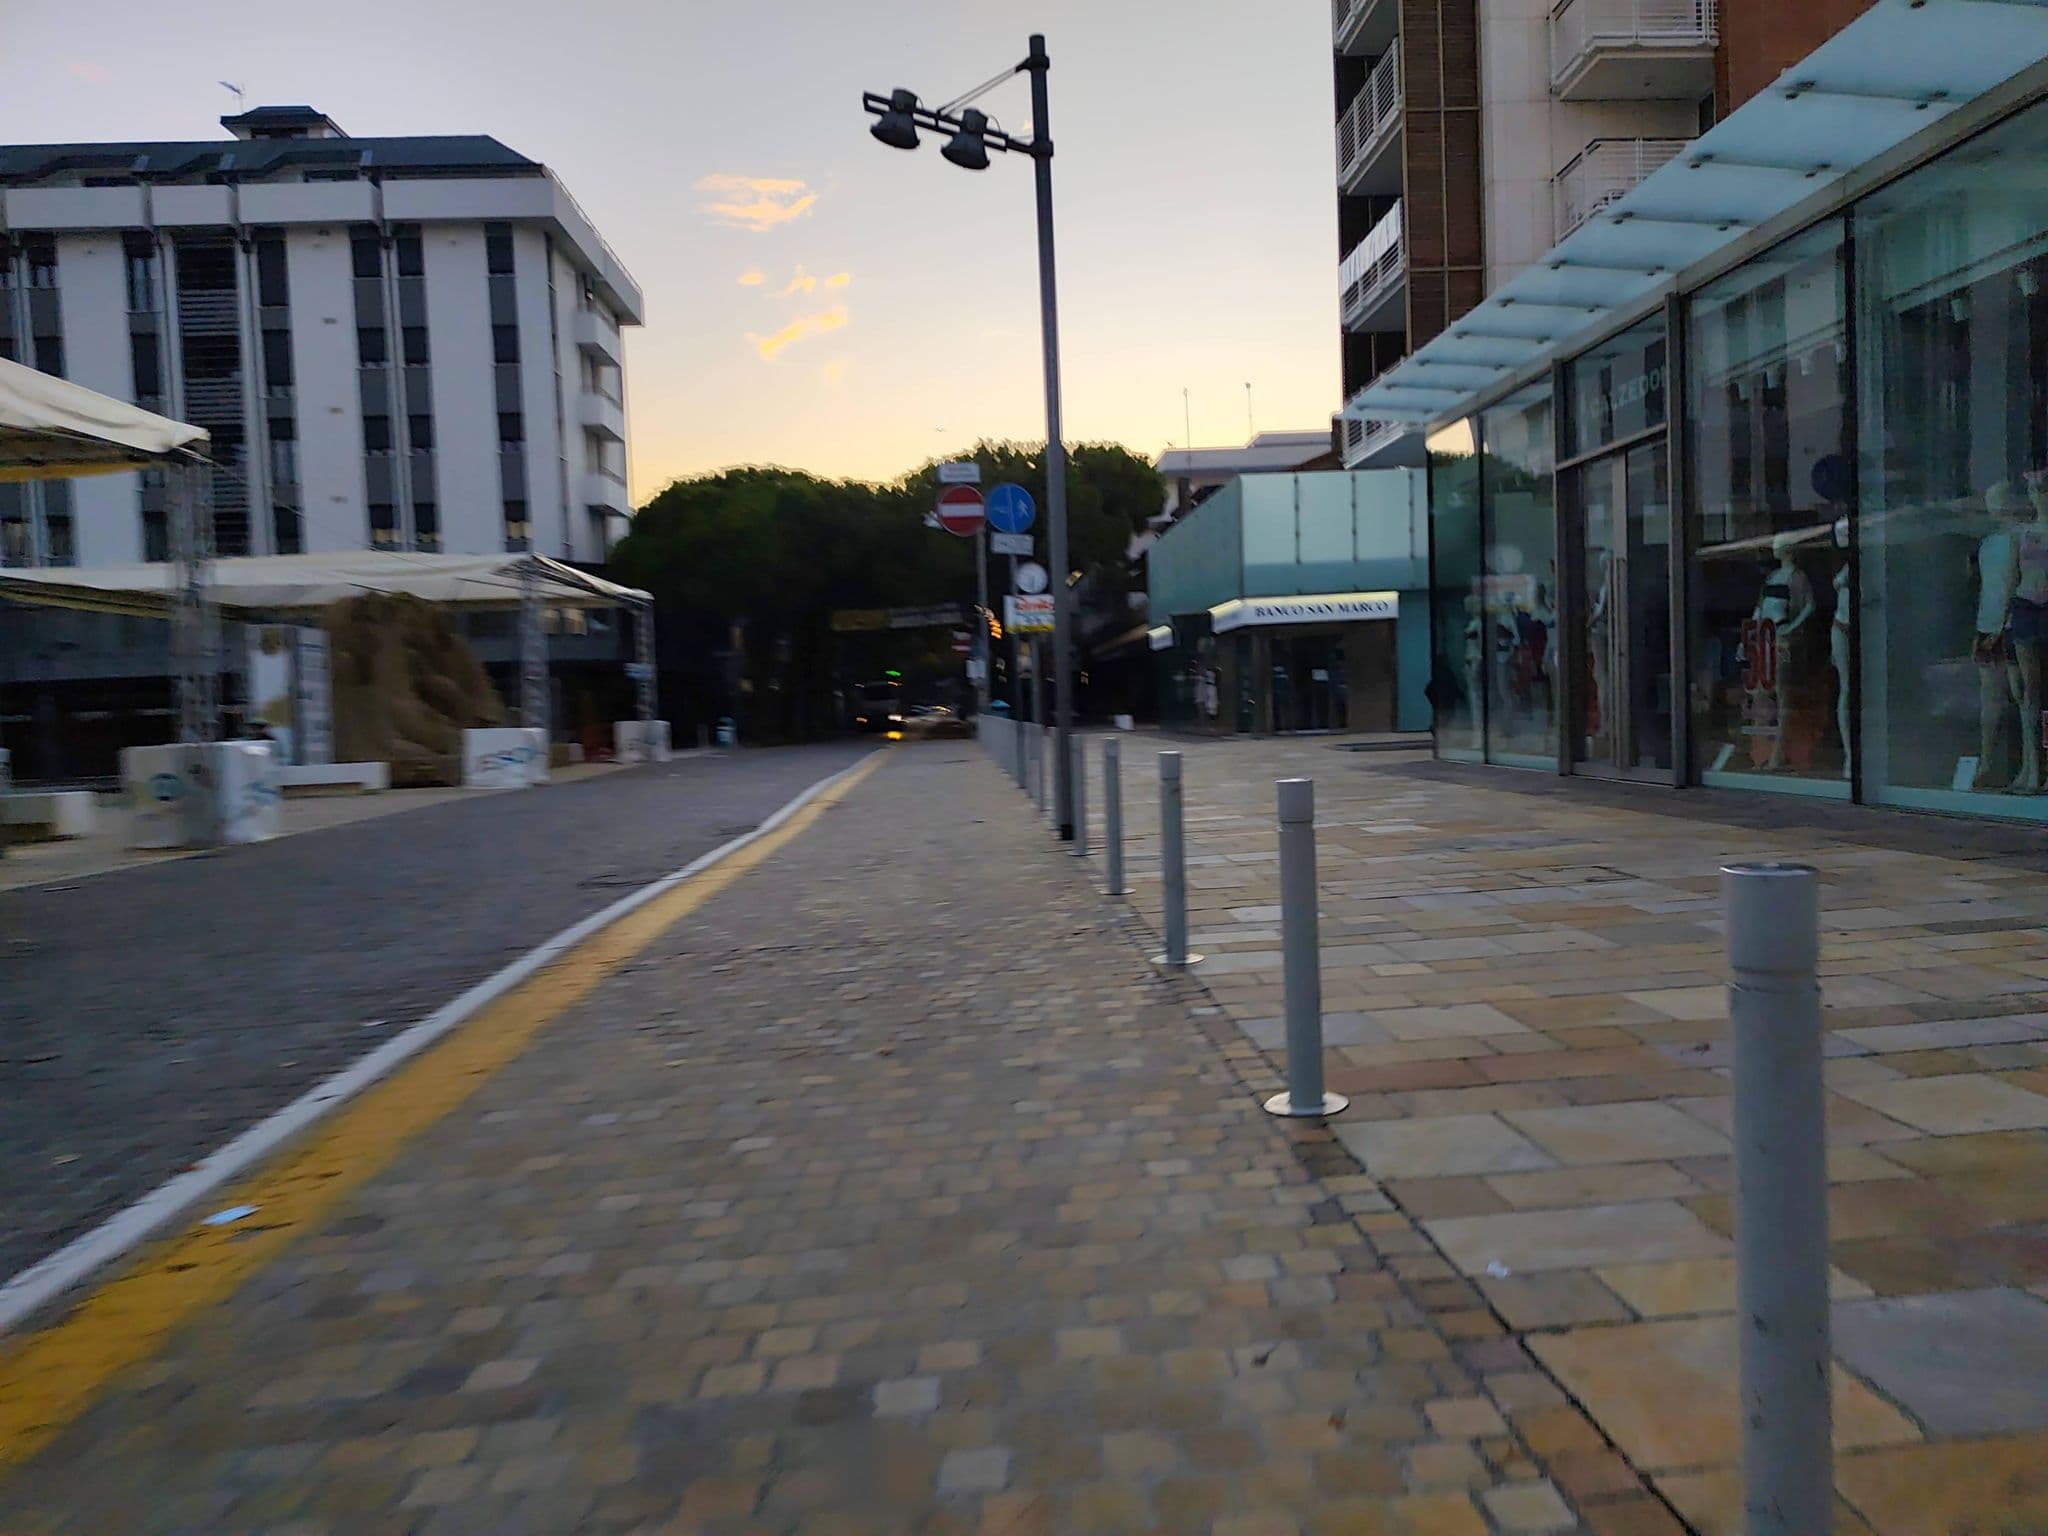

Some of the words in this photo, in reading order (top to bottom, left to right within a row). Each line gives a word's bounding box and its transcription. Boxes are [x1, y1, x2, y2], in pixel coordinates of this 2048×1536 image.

[1255, 605, 1303, 618] BANCO
[1306, 602, 1333, 615] SAN
[1337, 600, 1388, 613] MARCO
